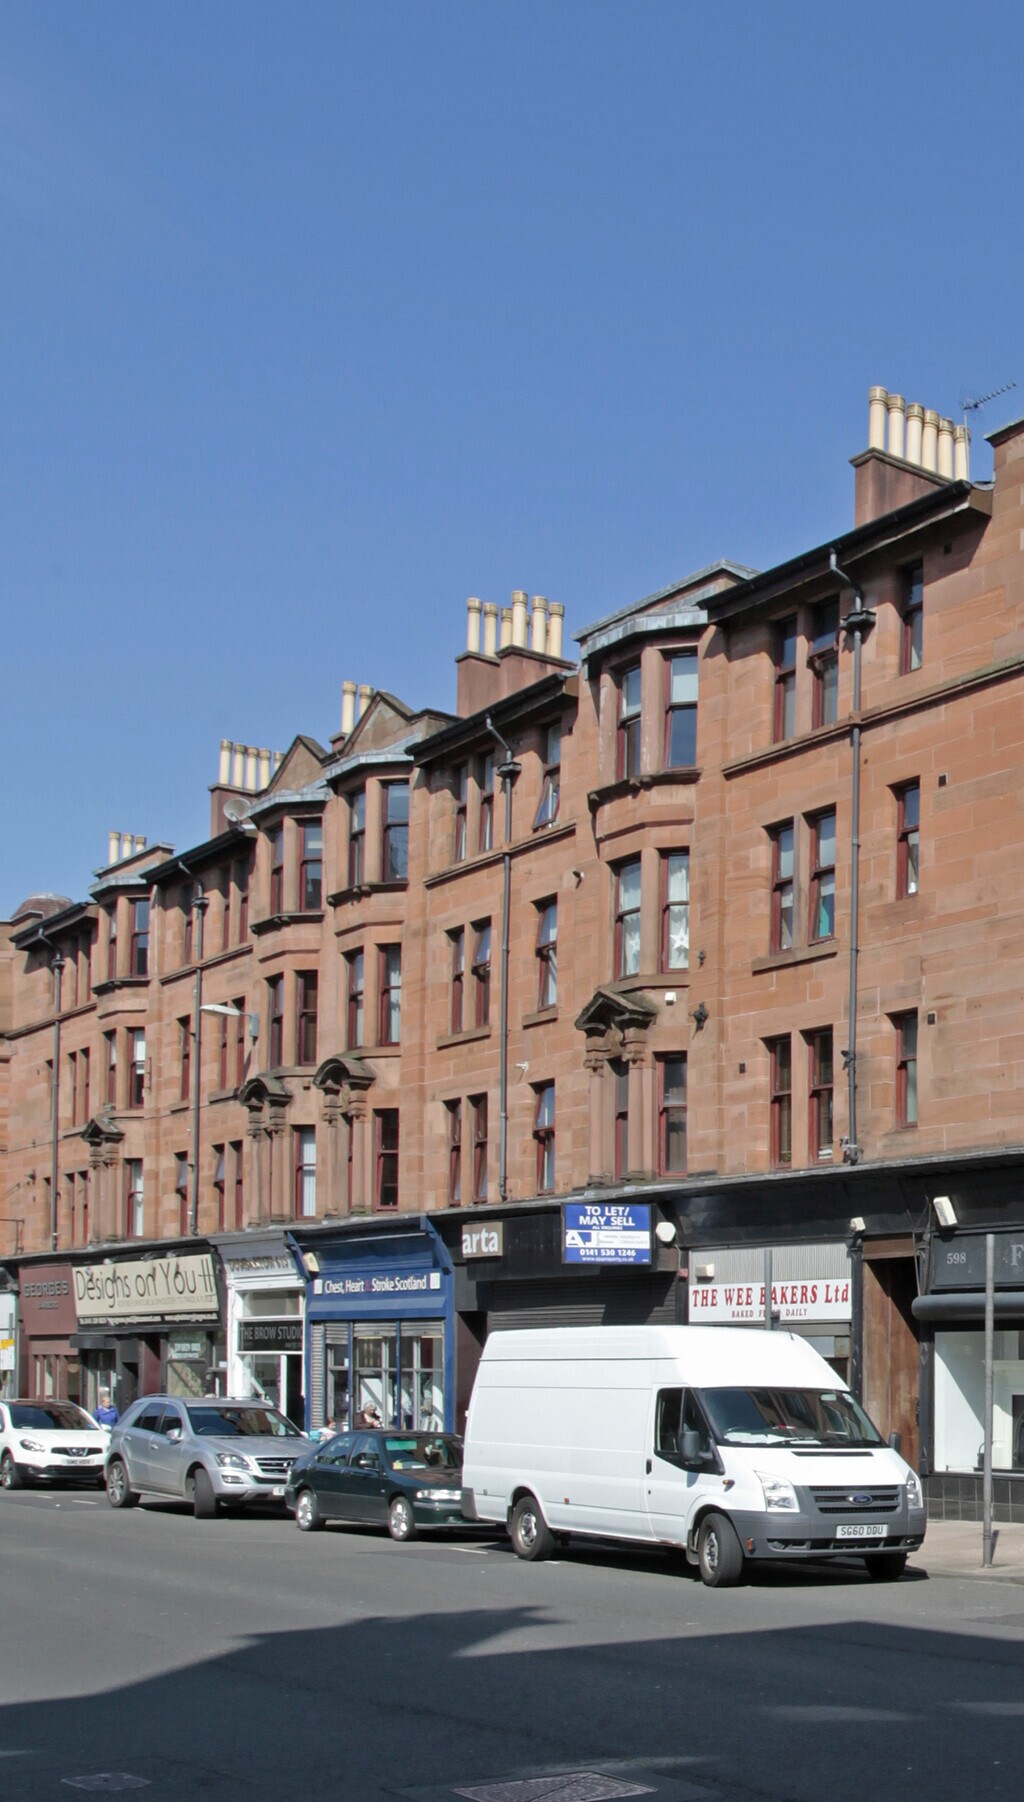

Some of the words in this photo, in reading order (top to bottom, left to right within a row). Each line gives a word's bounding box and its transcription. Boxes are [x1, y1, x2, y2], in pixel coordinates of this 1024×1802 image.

[584, 1206, 601, 1216] TO
[604, 1206, 630, 1216] LET/
[579, 1216, 606, 1225] MAY
[610, 1217, 636, 1226] SELL
[462, 1227, 499, 1254] arta
[946, 1252, 967, 1265] 598
[135, 1274, 158, 1297] on
[160, 1262, 197, 1294] You
[325, 1280, 344, 1294] Chest,
[345, 1280, 364, 1292] Heart
[372, 1278, 394, 1292] Stroke
[395, 1275, 427, 1291] Scotland
[693, 1288, 718, 1307] THE
[724, 1287, 753, 1306] WEE
[825, 1283, 849, 1304] Ltd
[731, 1309, 754, 1318] BAKED
[786, 1308, 808, 1317] DAILY
[240, 1327, 253, 1339] THE
[255, 1326, 276, 1340] BROW
[841, 1526, 864, 1536] SG60
[867, 1526, 883, 1535] DDU
